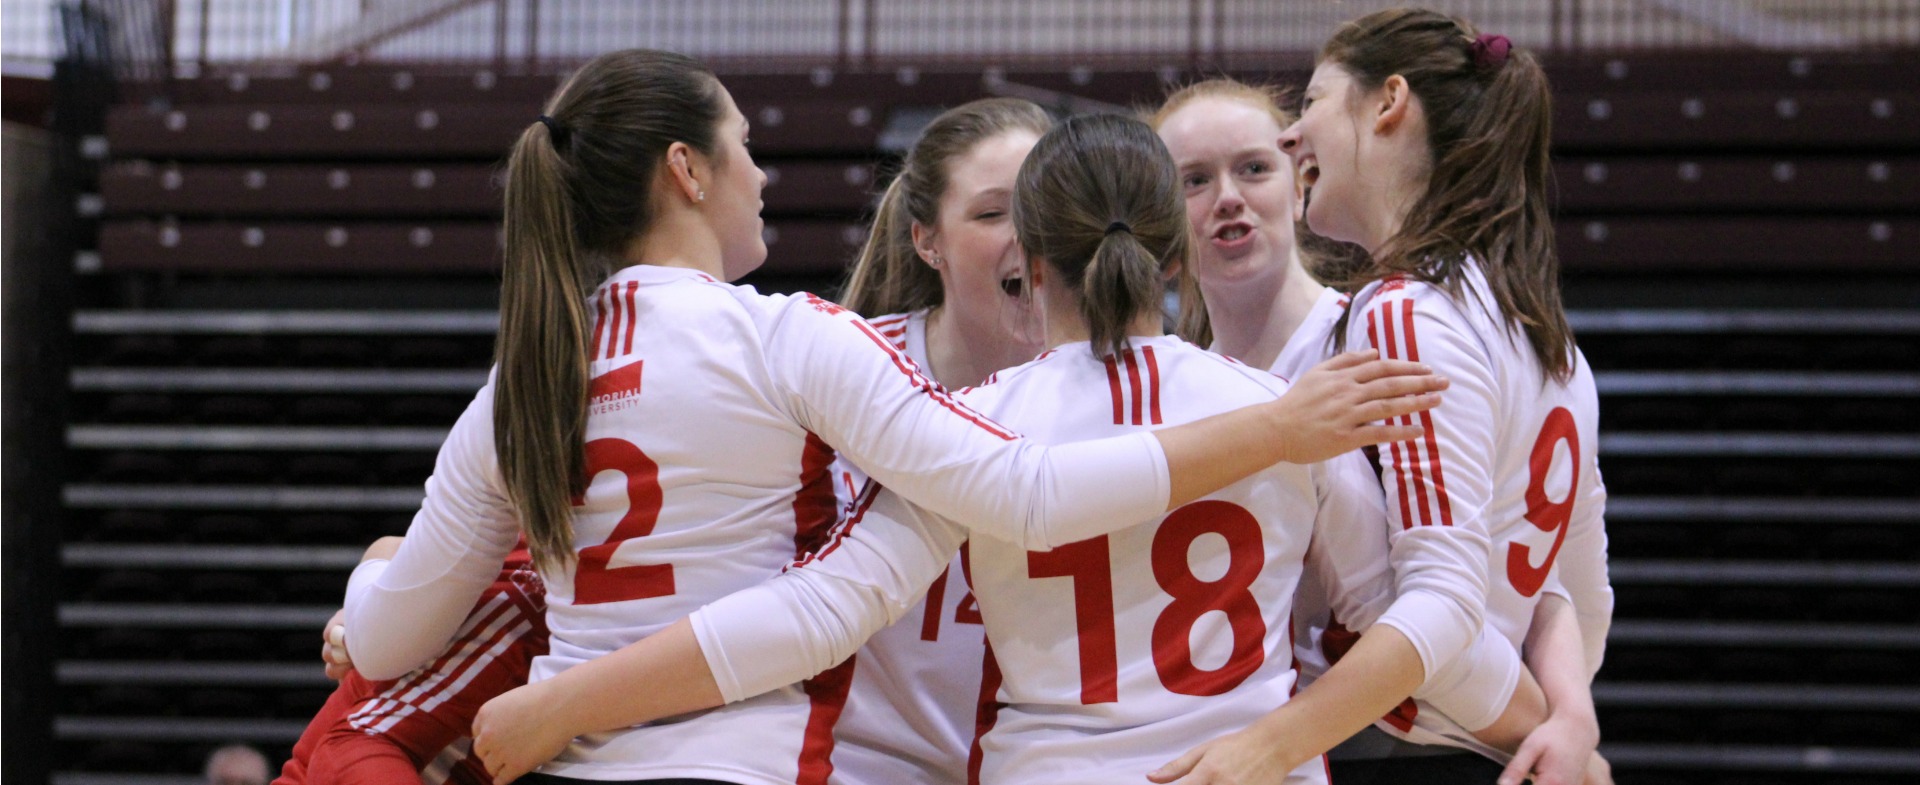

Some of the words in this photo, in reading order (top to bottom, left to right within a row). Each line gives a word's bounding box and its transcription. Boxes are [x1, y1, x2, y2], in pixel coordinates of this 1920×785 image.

[571, 437, 676, 606] 2
[1506, 406, 1580, 597] 9
[1027, 499, 1266, 705] 18
